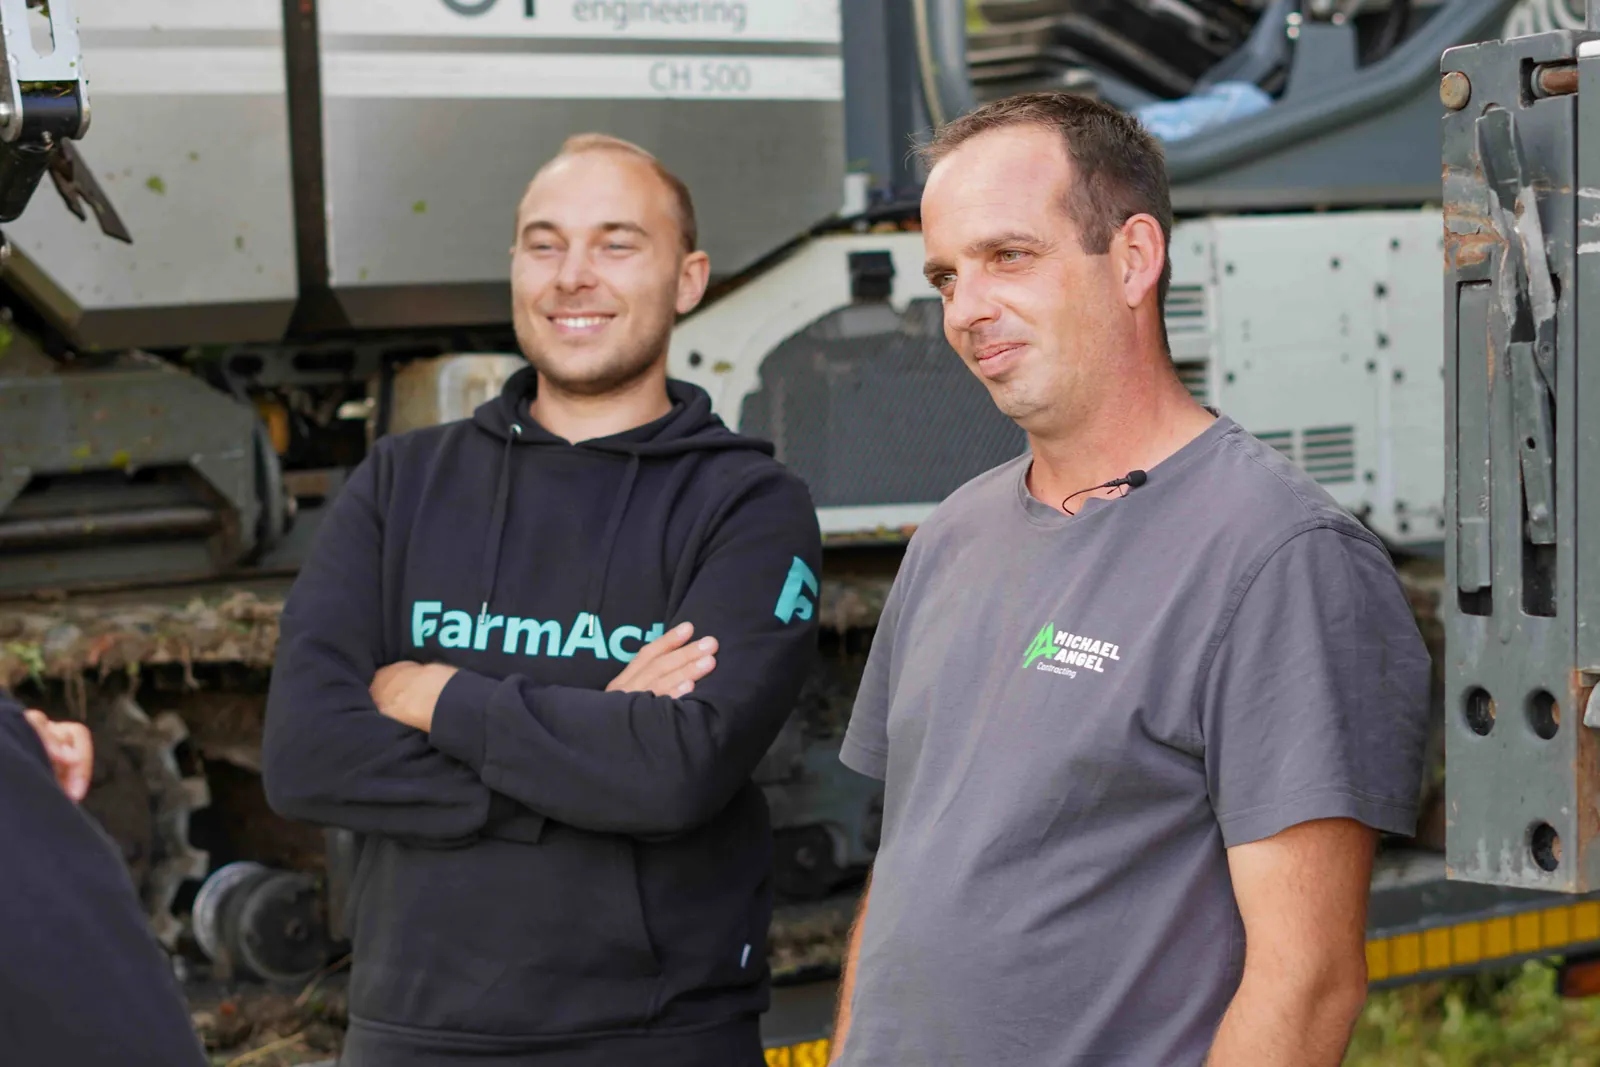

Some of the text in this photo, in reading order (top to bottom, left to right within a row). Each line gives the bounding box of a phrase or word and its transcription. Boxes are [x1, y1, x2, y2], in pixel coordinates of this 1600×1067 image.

[572, 0, 746, 33] engineering
[649, 62, 751, 91] CH 500
[1053, 630, 1120, 660] MICHAEL
[1036, 661, 1077, 679] Contracting
[1053, 648, 1104, 672] ANGEL
